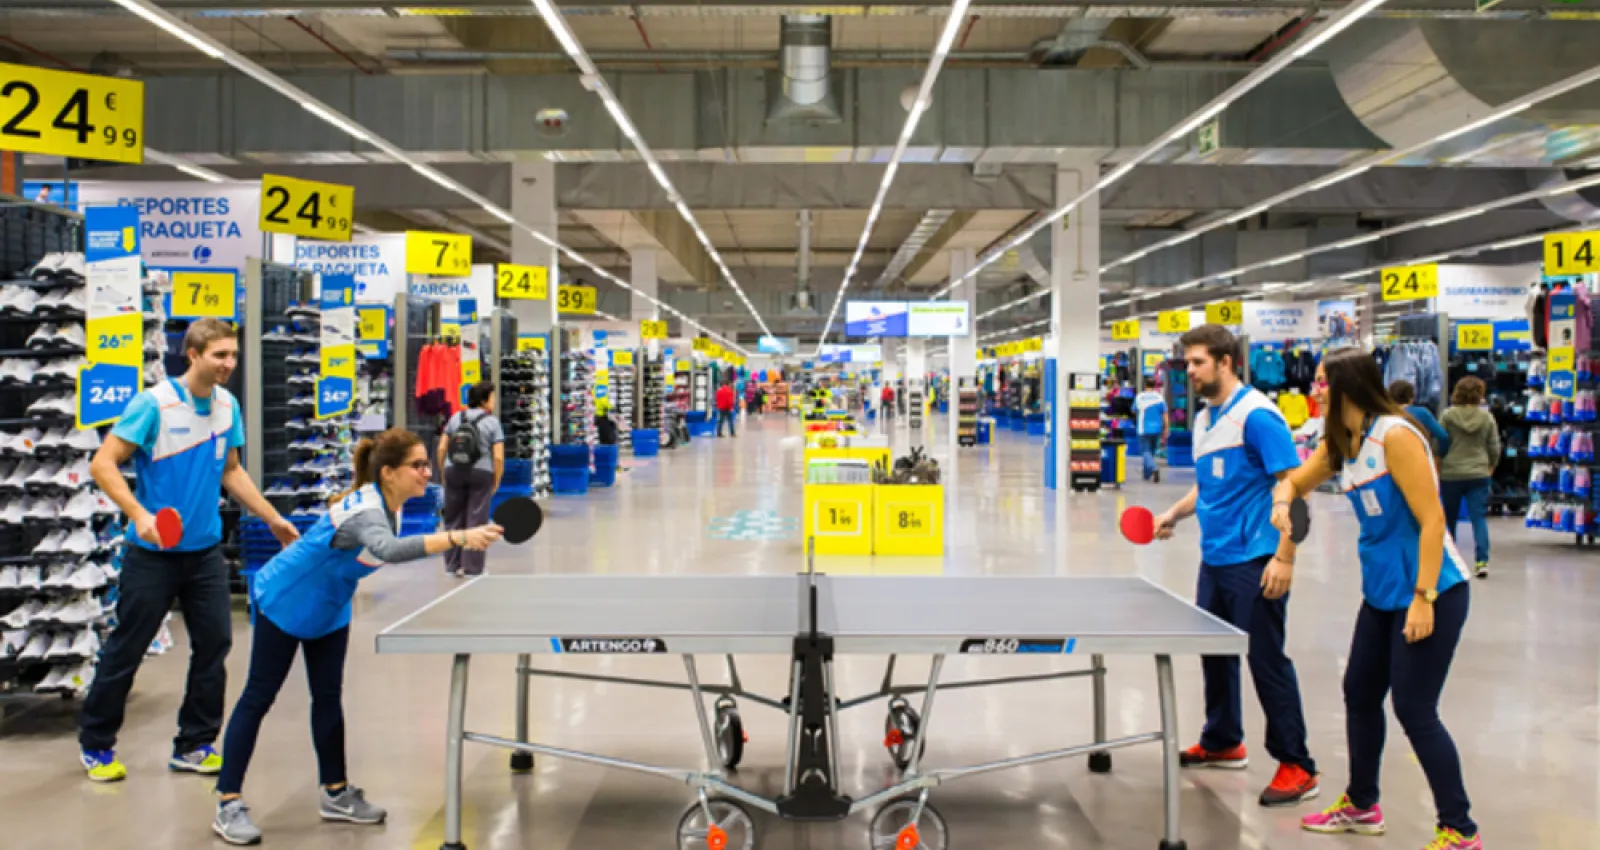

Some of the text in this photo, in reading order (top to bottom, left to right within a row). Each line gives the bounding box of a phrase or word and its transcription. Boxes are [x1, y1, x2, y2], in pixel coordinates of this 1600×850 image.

[1, 80, 95, 143] 24
[264, 185, 322, 229] 24
[141, 221, 241, 239] RAQUETA
[296, 244, 380, 259] DEPORTES
[431, 239, 449, 268] 7
[1551, 239, 1595, 267] 14
[500, 270, 531, 293] 24
[1385, 271, 1419, 296] 24
[187, 282, 202, 305] 7
[558, 289, 583, 309] 39
[1218, 305, 1231, 322] 9
[98, 334, 120, 349] 26
[89, 386, 116, 404] 24
[829, 507, 837, 525] 1
[898, 510, 909, 529] 8
[570, 640, 641, 653] ARTENGO
